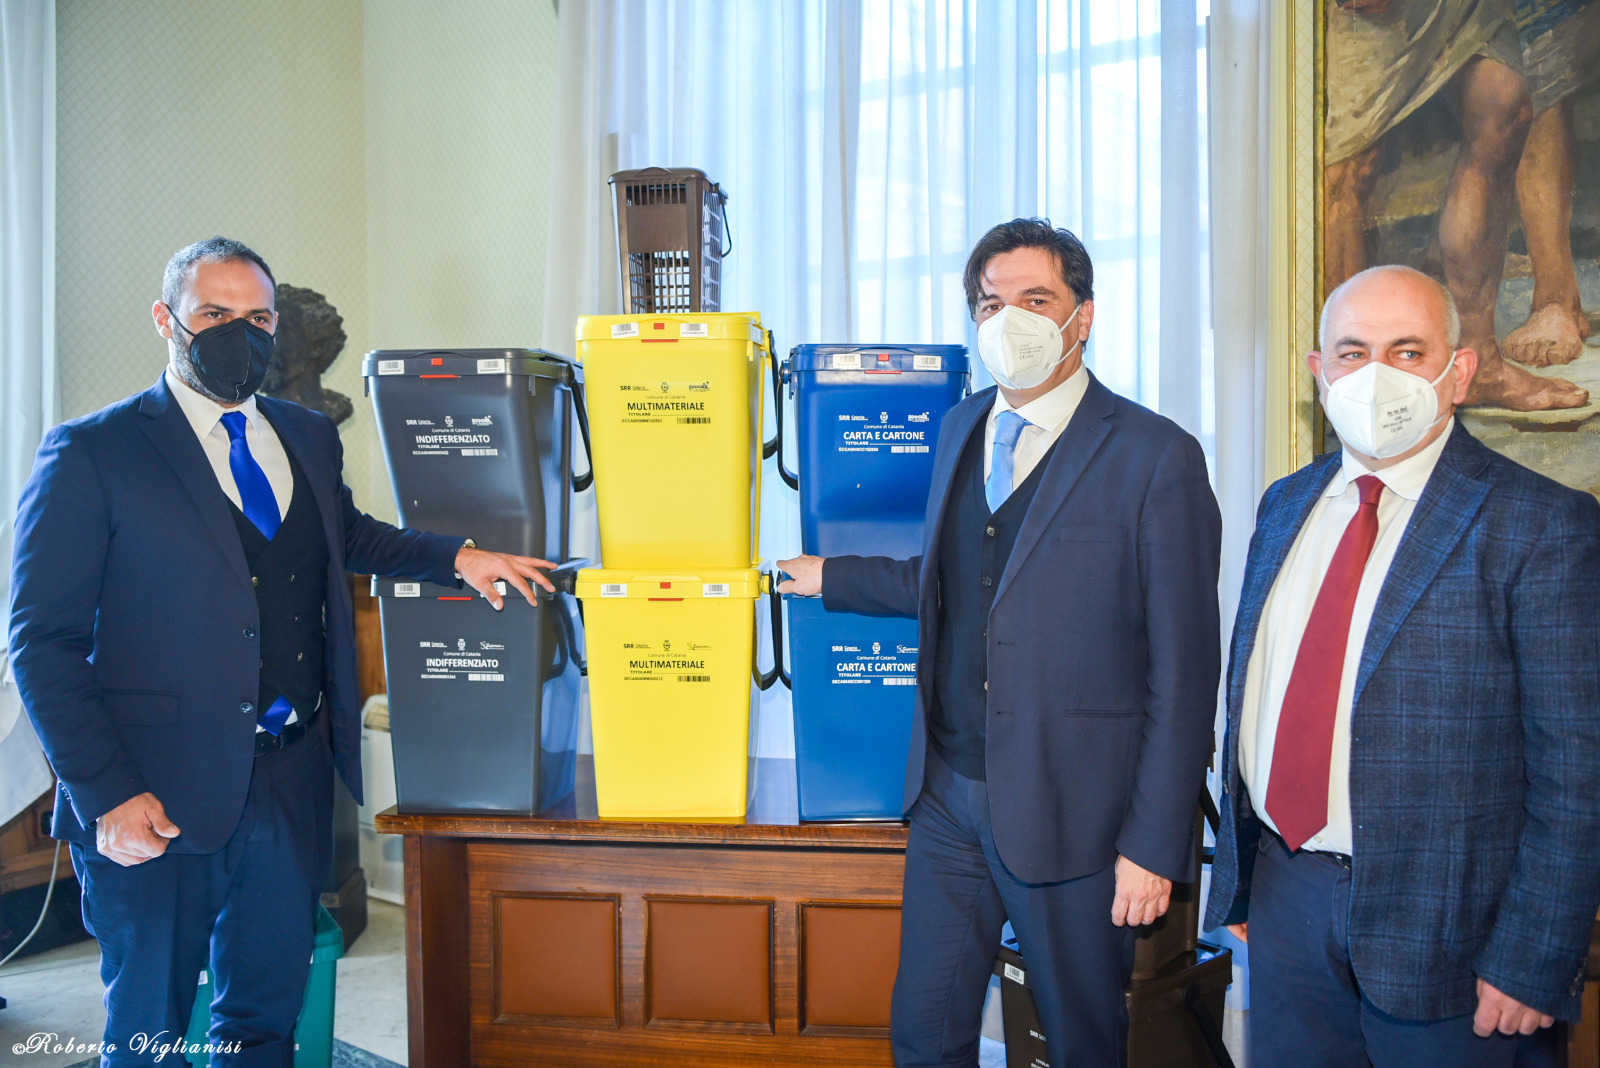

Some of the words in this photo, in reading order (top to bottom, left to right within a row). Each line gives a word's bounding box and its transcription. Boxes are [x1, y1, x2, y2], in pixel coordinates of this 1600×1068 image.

[627, 402, 704, 411] MULTIMATERIALE
[416, 434, 490, 444] INDIFFERENZIATO
[843, 431, 873, 440] CARTA
[875, 431, 880, 440] E
[882, 431, 924, 440] CARTONE
[426, 658, 498, 668] INDIFFERENZIATO
[630, 660, 704, 668] MULTIMATERIALE
[836, 663, 866, 672] CARTA
[868, 663, 873, 672] E
[874, 663, 916, 672] CARTONE
